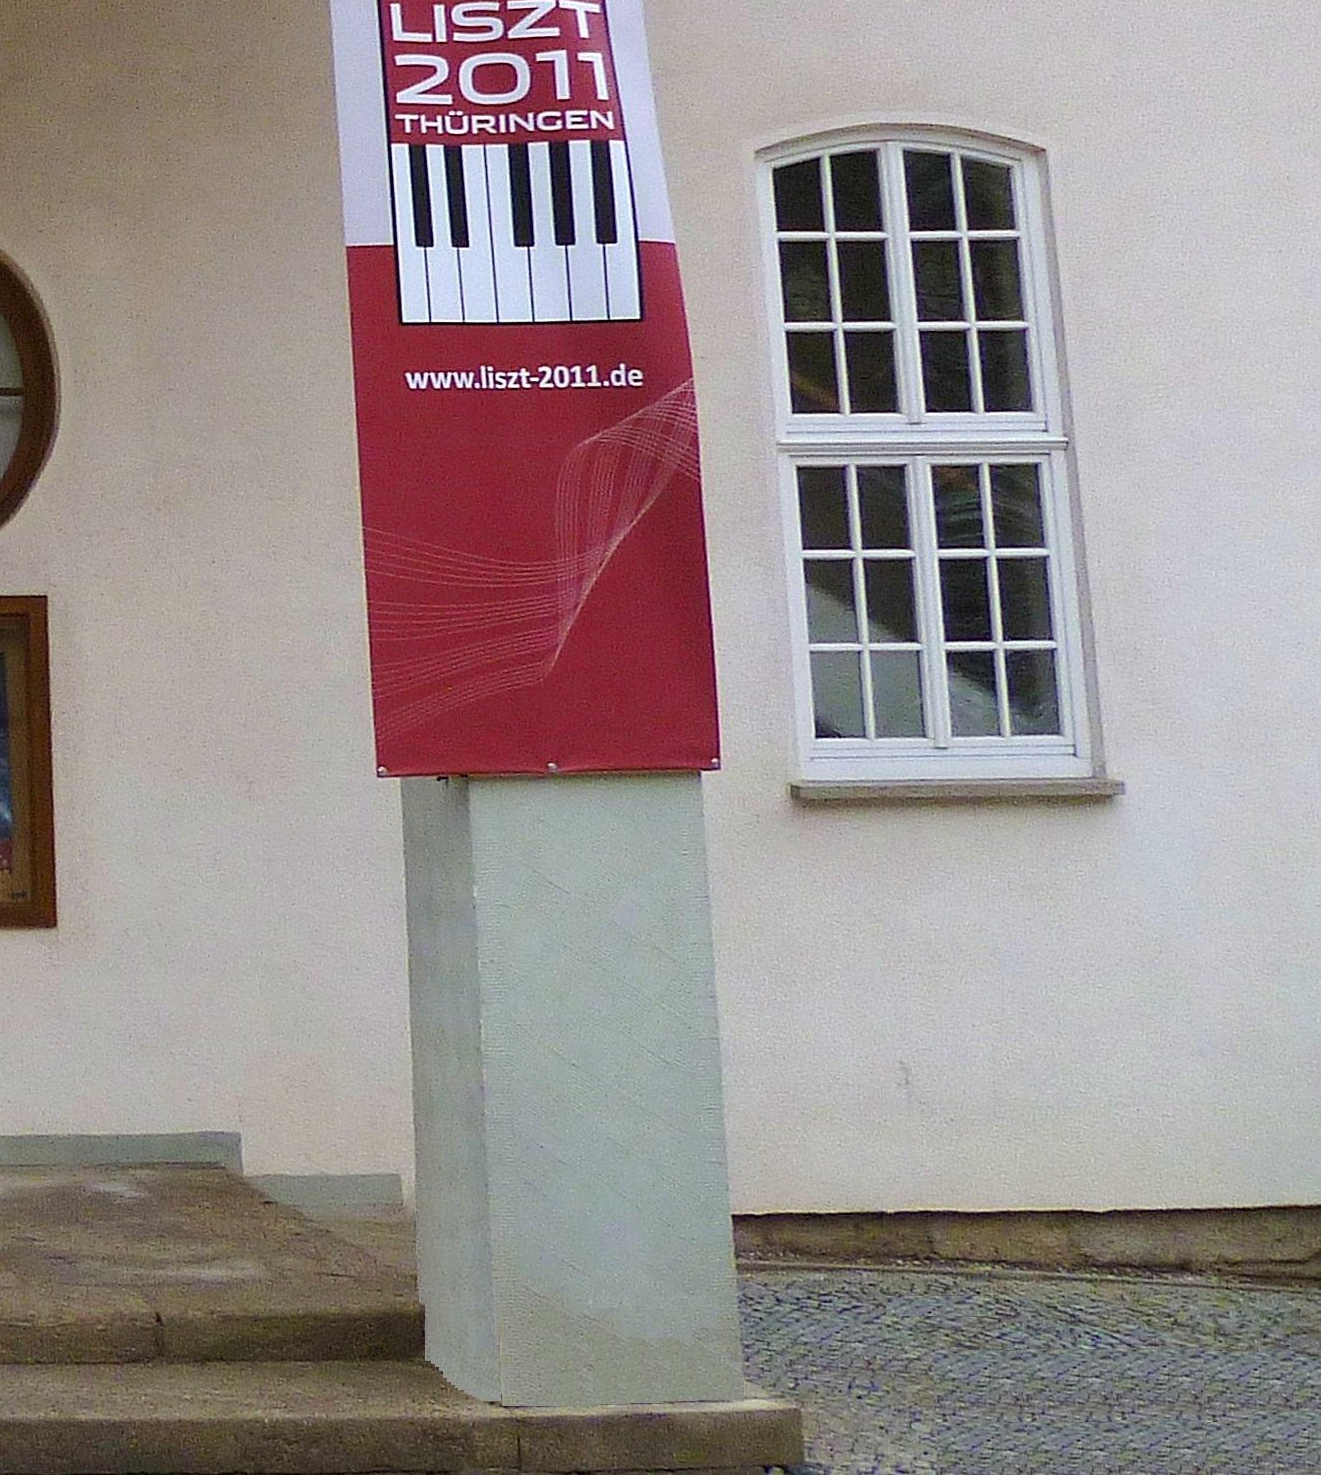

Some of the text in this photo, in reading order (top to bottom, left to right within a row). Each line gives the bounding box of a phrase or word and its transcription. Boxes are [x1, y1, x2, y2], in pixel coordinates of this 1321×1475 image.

[394, 49, 609, 105] 2011
[394, 110, 615, 135] THÜRINGEN
[405, 362, 644, 389] www.liszt-2011.de
